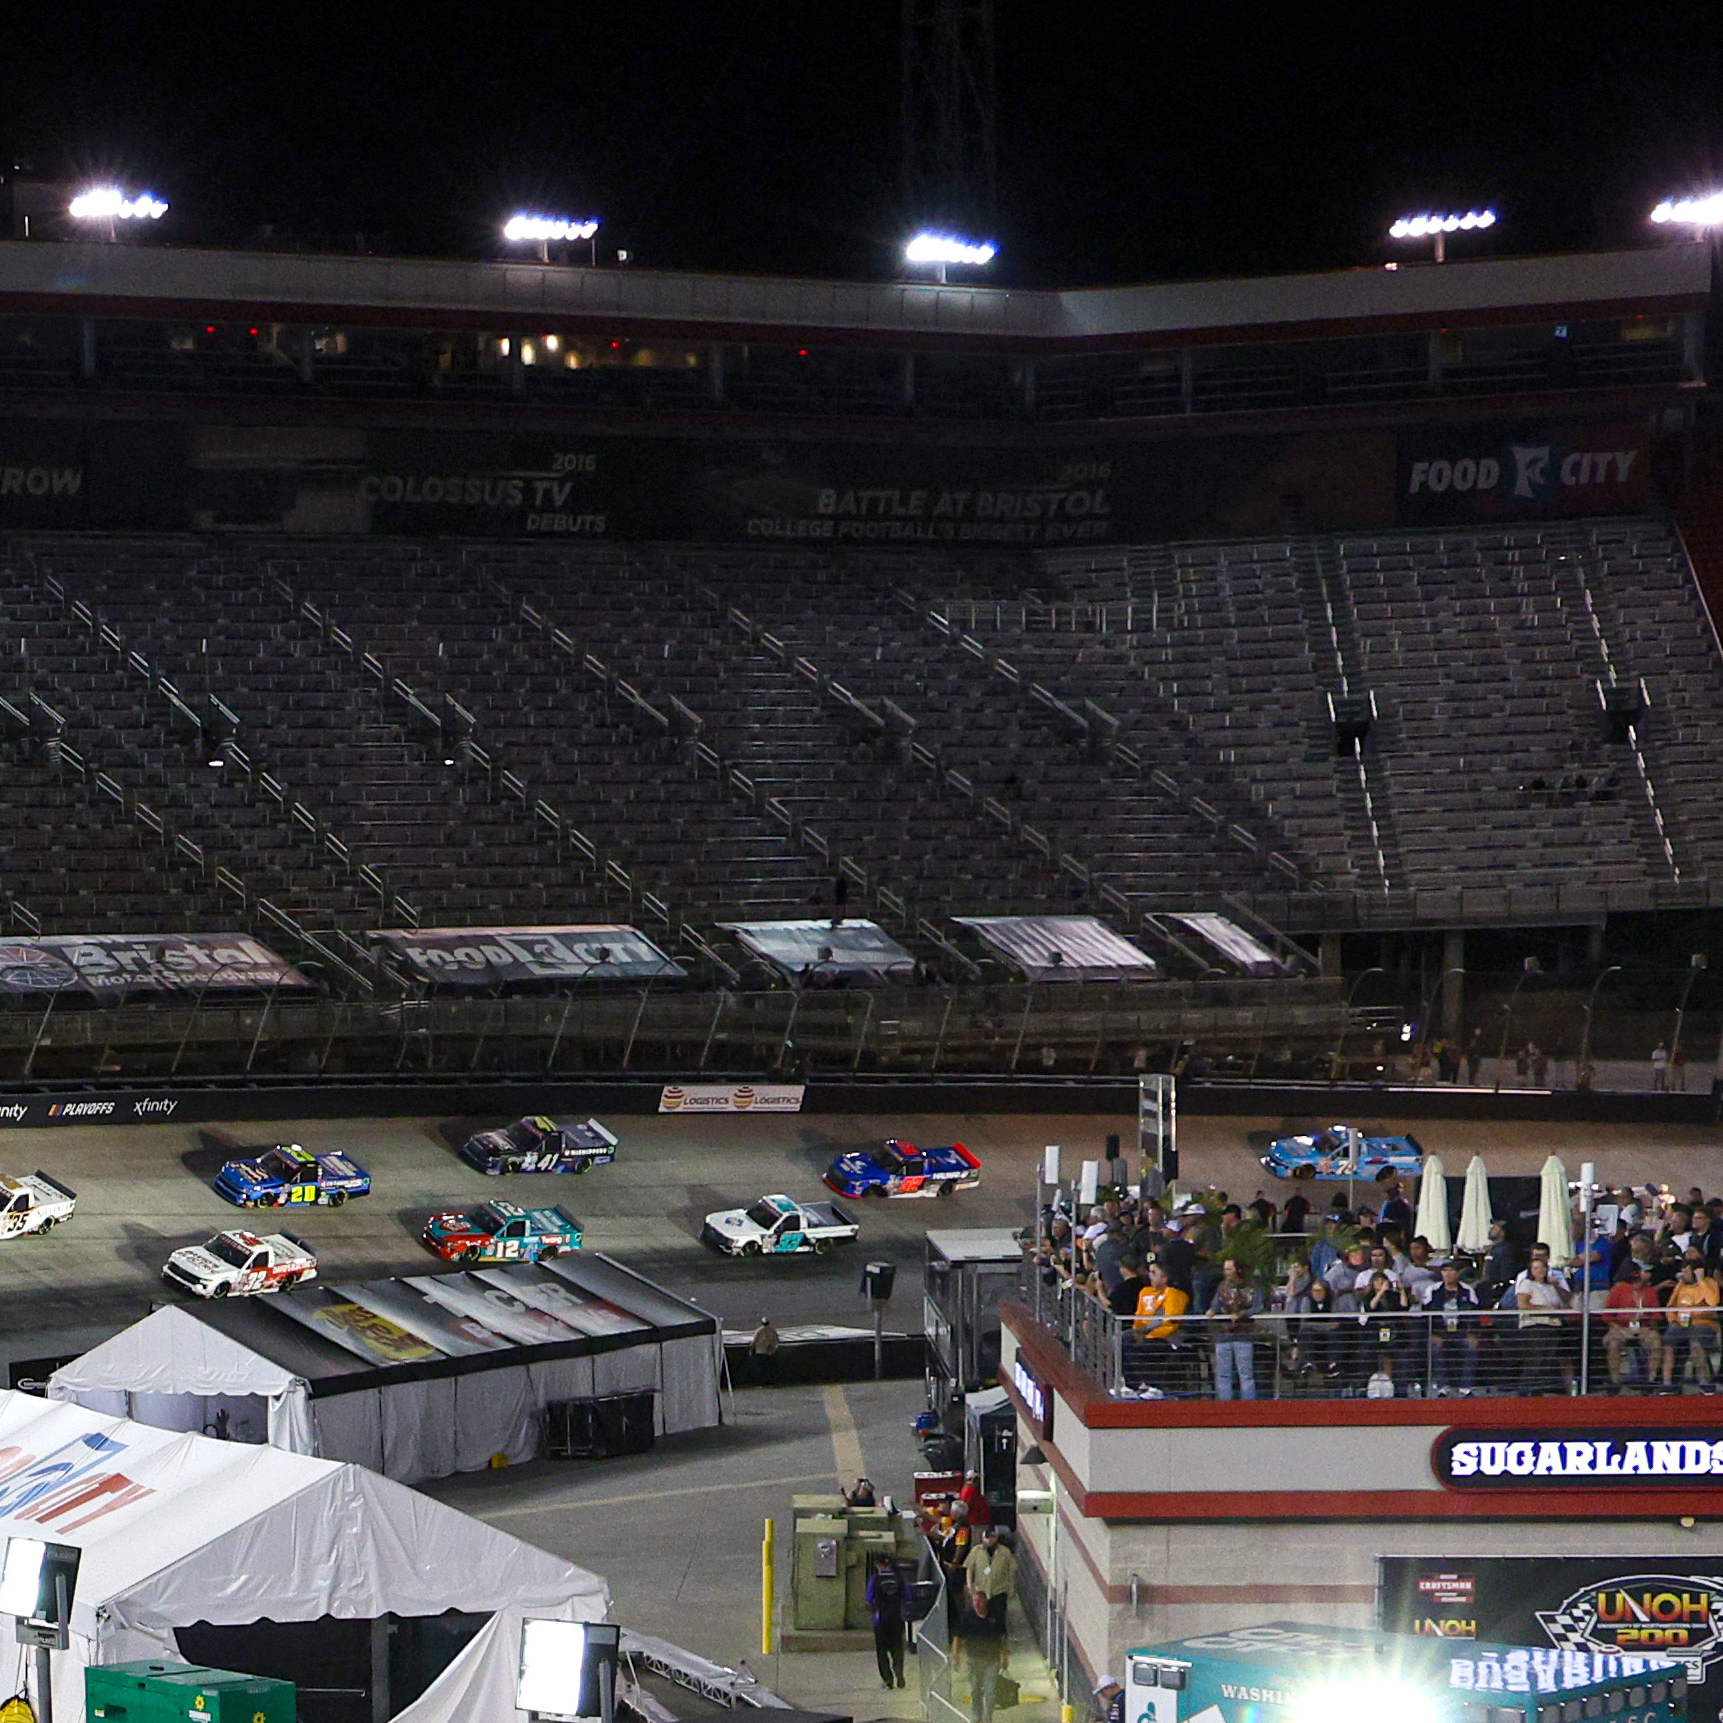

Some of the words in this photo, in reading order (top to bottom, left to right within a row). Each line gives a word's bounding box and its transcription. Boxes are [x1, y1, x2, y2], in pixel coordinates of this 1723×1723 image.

[552, 453, 597, 474] 2016
[1408, 459, 1501, 494] FOOD
[1560, 451, 1638, 486] CITY
[358, 475, 523, 507] COLOSSUS
[530, 481, 574, 508] TV
[817, 488, 929, 516] BATTLE
[978, 488, 1112, 516] BRISTOL
[526, 513, 607, 534] DEBUTS
[747, 518, 833, 539] COLLEGE
[69, 940, 272, 976] Bristol
[62, 1101, 116, 1116] PLAYOFFS
[133, 1097, 179, 1116] xfinity
[682, 1096, 730, 1106] LOGISTICS
[753, 1096, 802, 1106] LOGISTICS
[290, 1183, 316, 1202] 20
[495, 1239, 521, 1258] 12
[1418, 1579, 1473, 1590] CRAFTSMAN
[1597, 1588, 1710, 1624] UNOH
[1414, 1617, 1477, 1638] UNOH
[1615, 1629, 1689, 1646] 200
